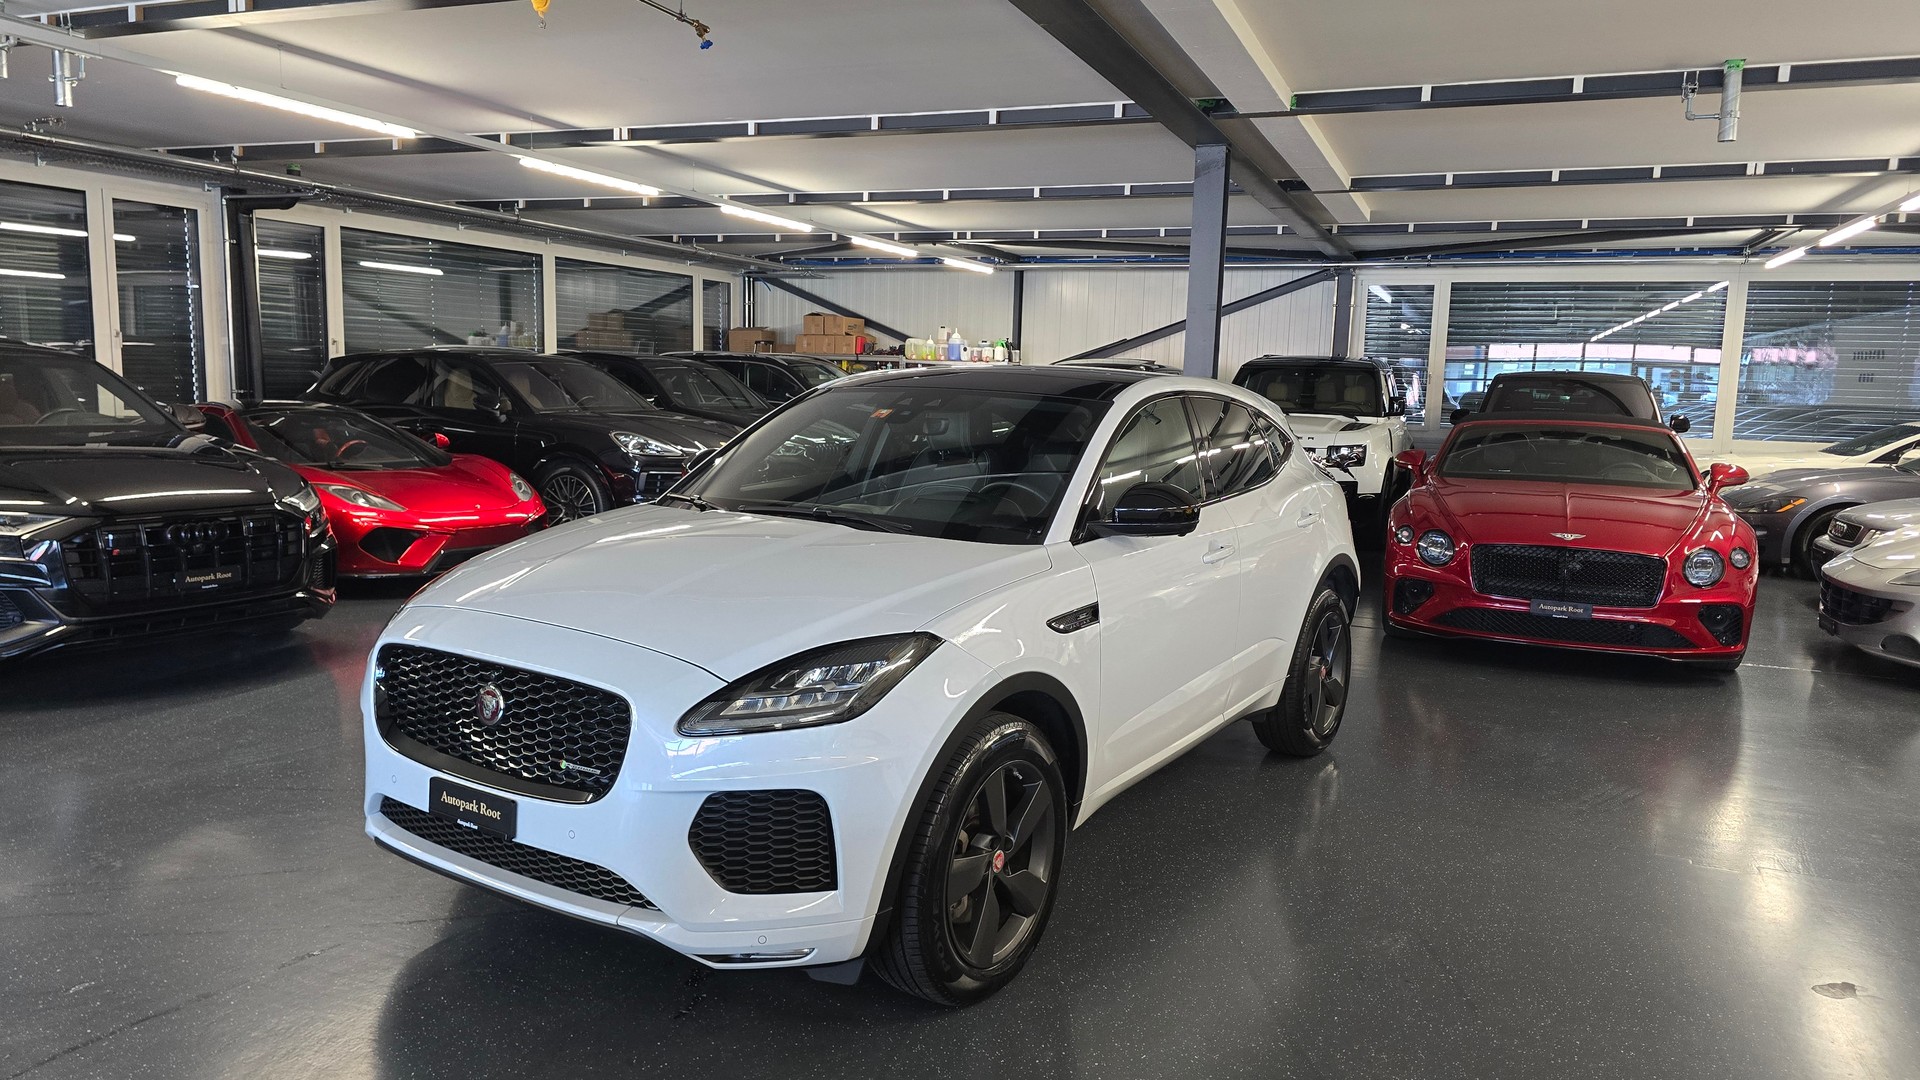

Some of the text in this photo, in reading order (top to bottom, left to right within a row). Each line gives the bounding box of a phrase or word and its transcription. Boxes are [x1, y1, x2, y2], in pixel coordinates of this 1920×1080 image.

[185, 572, 233, 583] Autopark Root
[1538, 603, 1585, 614] Autopark Root
[440, 790, 502, 821] Autopark Root
